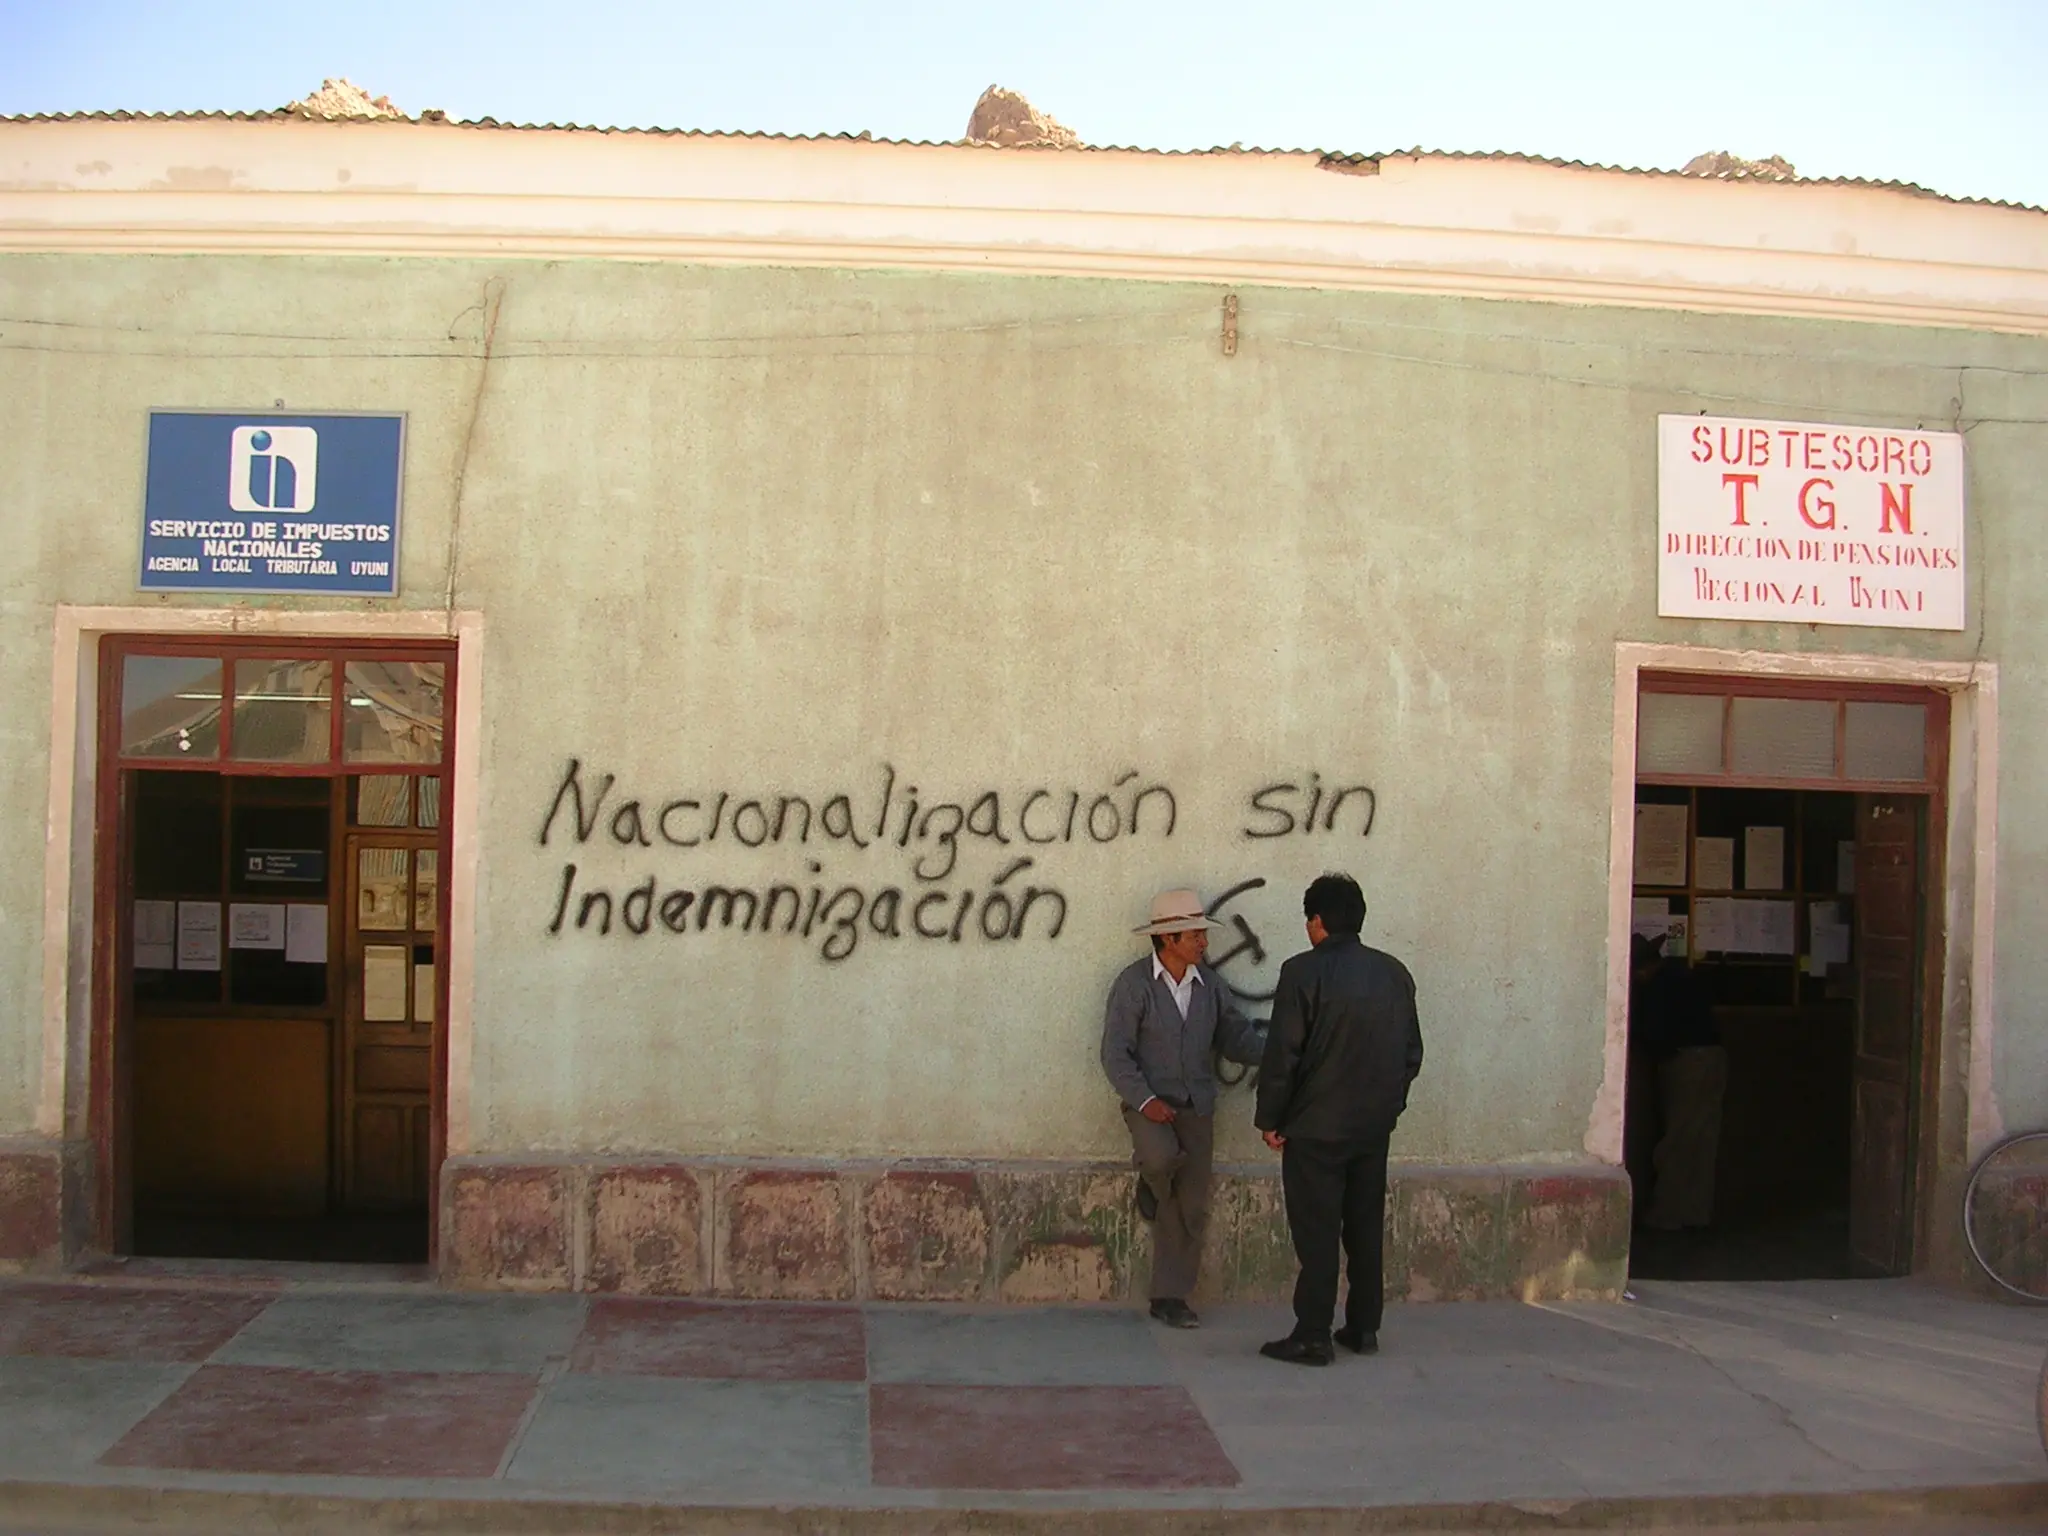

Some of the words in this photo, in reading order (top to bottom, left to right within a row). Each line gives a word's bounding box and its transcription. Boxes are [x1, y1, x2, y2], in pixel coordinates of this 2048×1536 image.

[1691, 425, 1932, 476] SUBTESORO
[1722, 473, 1768, 526] T.
[1798, 478, 1848, 530] G.
[1878, 482, 1929, 536] N.
[150, 520, 245, 538] SERVICIO
[251, 522, 277, 539] DE
[282, 523, 390, 542] IMPUESTOS
[203, 540, 323, 559] NACIONALES
[1667, 533, 1791, 560] DIRECCION
[1798, 539, 1826, 561] DE
[1832, 542, 1957, 570] PENSIONES
[148, 557, 199, 572] AGENCIA
[212, 559, 252, 574] LOCAL
[267, 559, 338, 575] TRIBUTARIA
[351, 562, 389, 576] UYUNI
[540, 758, 1176, 881] Nacionalización
[1244, 771, 1377, 839] sin
[548, 858, 1068, 961] Indemnización
